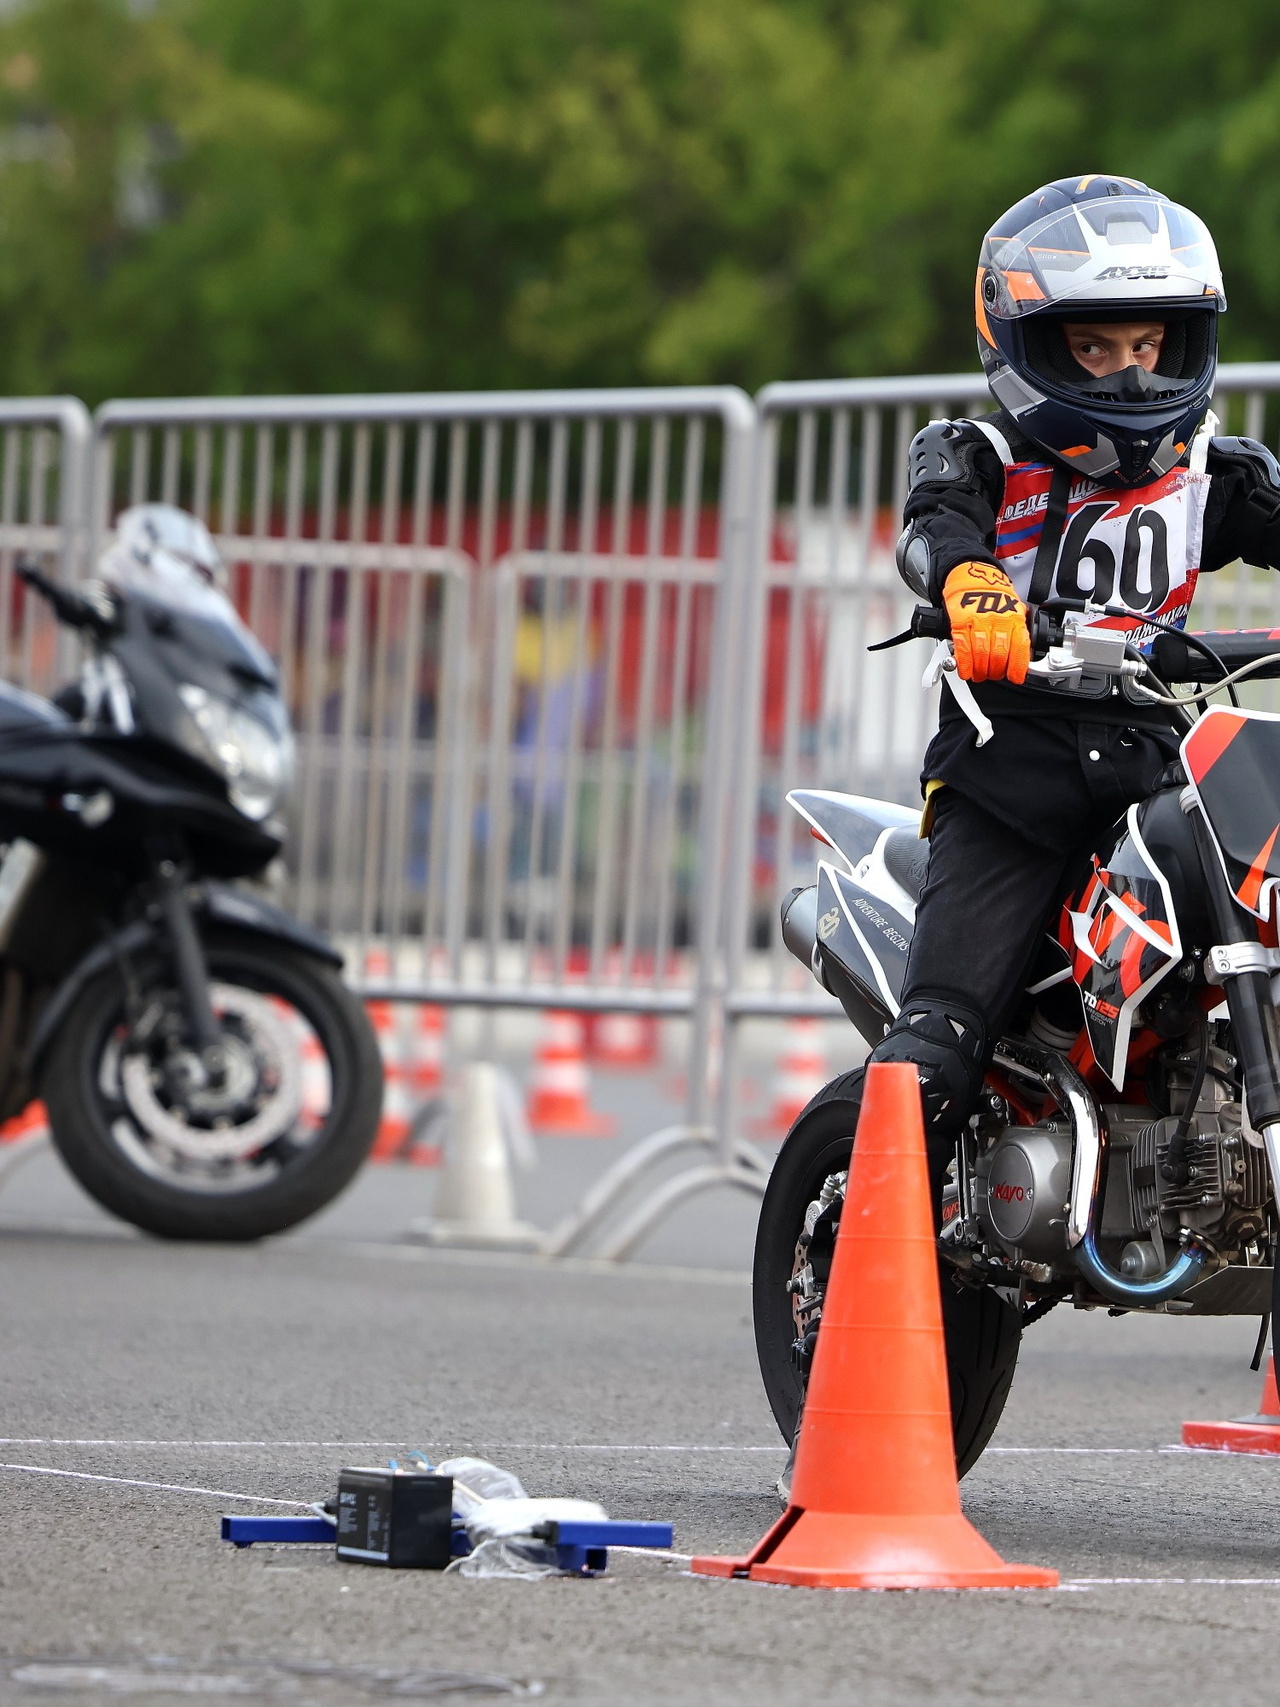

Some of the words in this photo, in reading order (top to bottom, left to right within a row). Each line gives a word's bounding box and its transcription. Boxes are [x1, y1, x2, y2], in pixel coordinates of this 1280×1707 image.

[1093, 265, 1171, 281] AXXIS
[1056, 501, 1170, 613] 60
[960, 592, 1019, 614] FOX
[852, 898, 889, 928] ADVENTURE
[882, 927, 910, 951] BEGINS
[1083, 990, 1120, 1019] TD125
[994, 1181, 1024, 1203] KAYO
